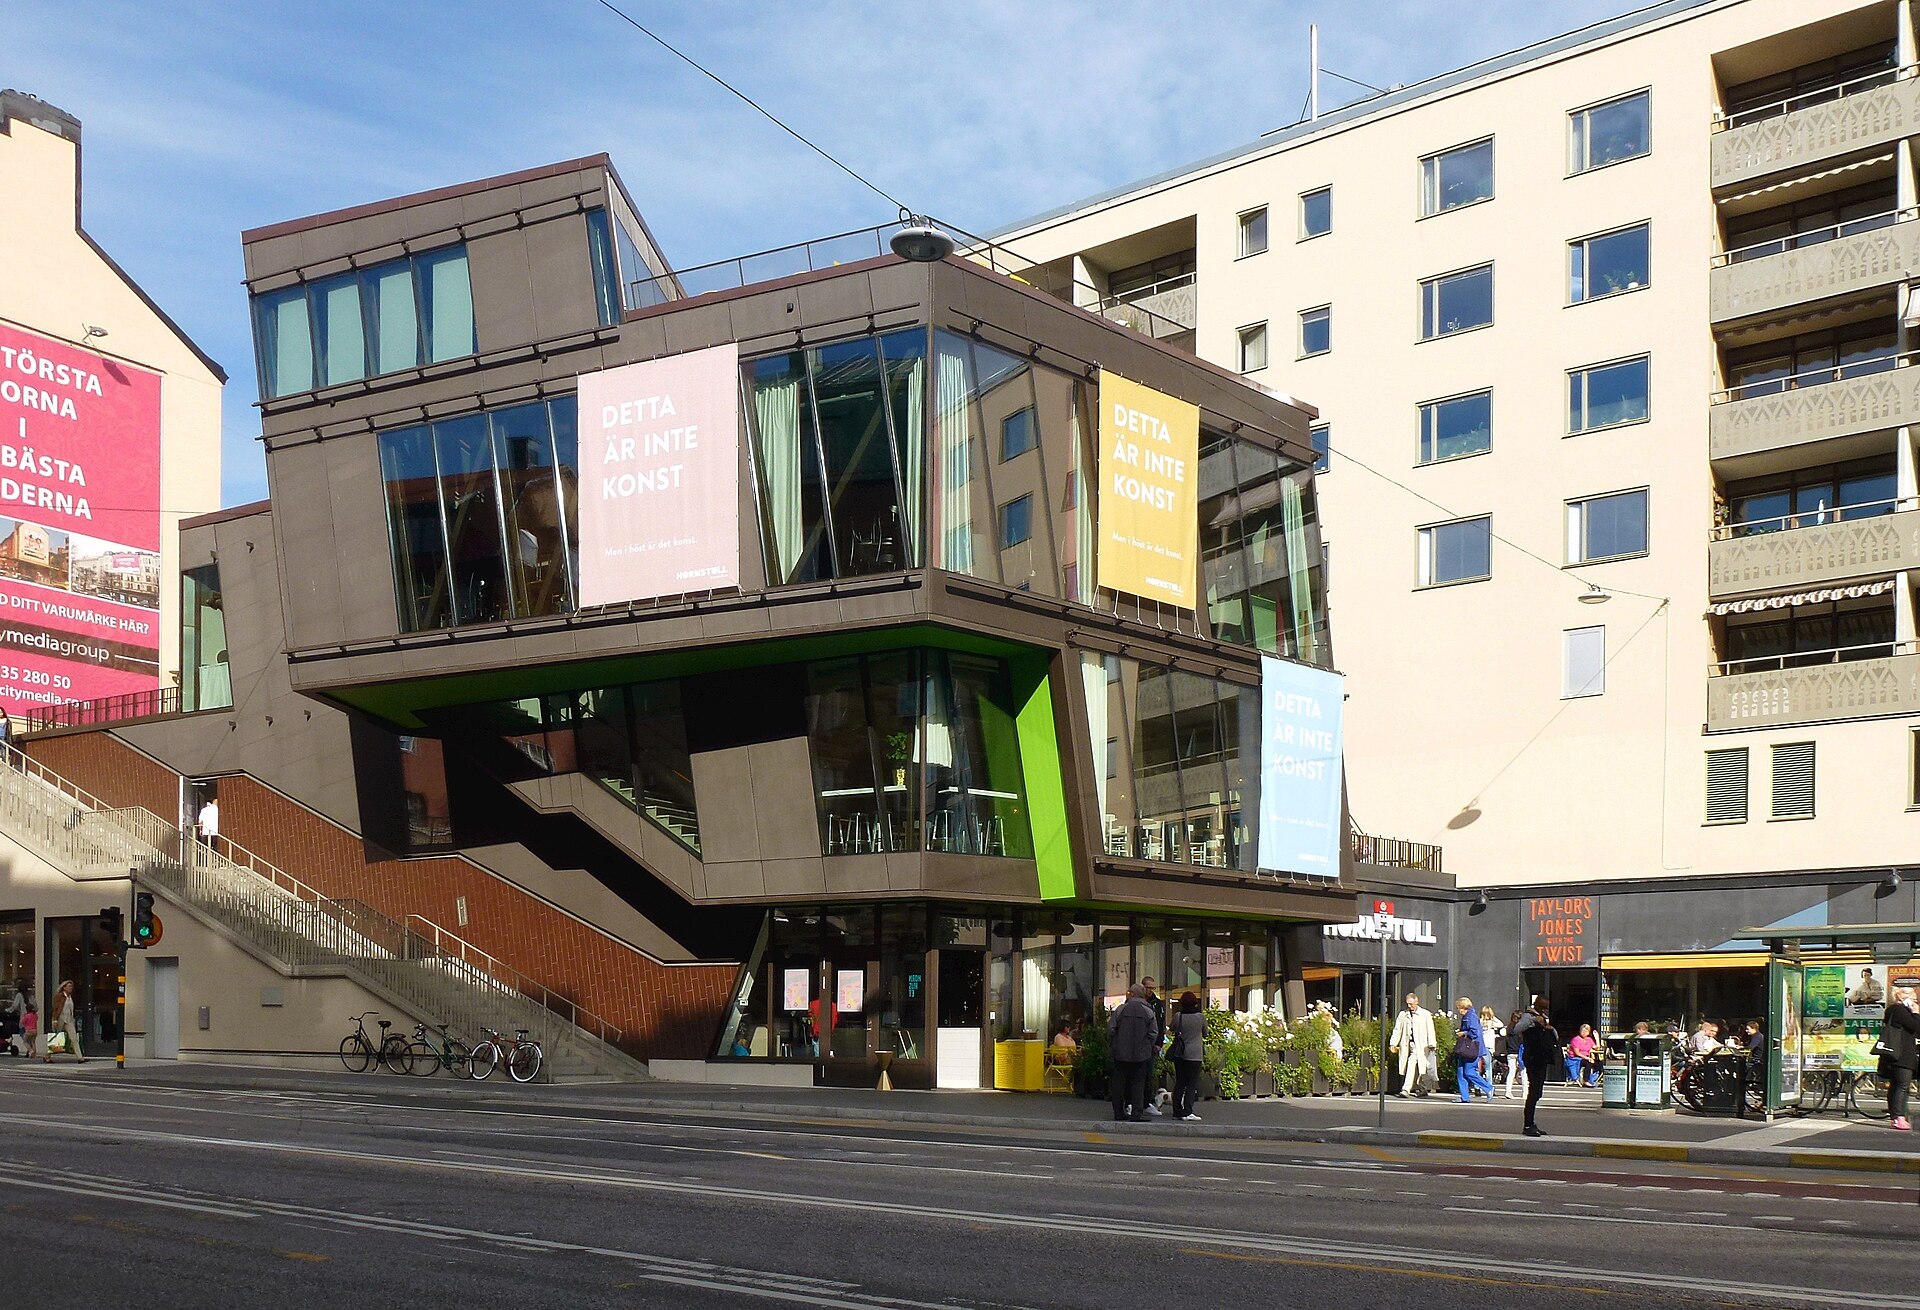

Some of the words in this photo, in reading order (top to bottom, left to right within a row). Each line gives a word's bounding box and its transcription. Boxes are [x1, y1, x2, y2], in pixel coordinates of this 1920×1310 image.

[0, 346, 103, 397] TÖRSTA
[0, 380, 78, 421] ORNA
[602, 394, 676, 429] DETTA
[19, 416, 27, 438] I
[1113, 403, 1171, 444] DETTA
[603, 435, 636, 465] ÄR
[643, 425, 698, 457] INTE
[1112, 433, 1139, 467] ÄR
[1144, 447, 1185, 482] INTE
[1, 445, 86, 487] BÄSTA
[602, 464, 684, 501] KONST
[1, 477, 93, 521] DERNA
[1113, 473, 1176, 512] KONST
[604, 547, 623, 558] Men
[658, 538, 671, 549] det
[11, 596, 40, 612] DITT
[41, 602, 117, 629] VARUMÄRKE
[119, 618, 149, 635] HÄR?
[22, 669, 50, 686] 280
[53, 676, 71, 689] 50
[1275, 690, 1322, 720] DETTA
[1273, 717, 1294, 744] ÄR
[1299, 727, 1332, 752] INTE
[1273, 753, 1325, 781] KONST
[1530, 898, 1592, 921] TAYLORS
[1538, 918, 1583, 936] JONES
[1324, 915, 1437, 944] HORNTULL
[1537, 945, 1583, 962] TWIST
[1844, 1020, 1882, 1028] LALEH
